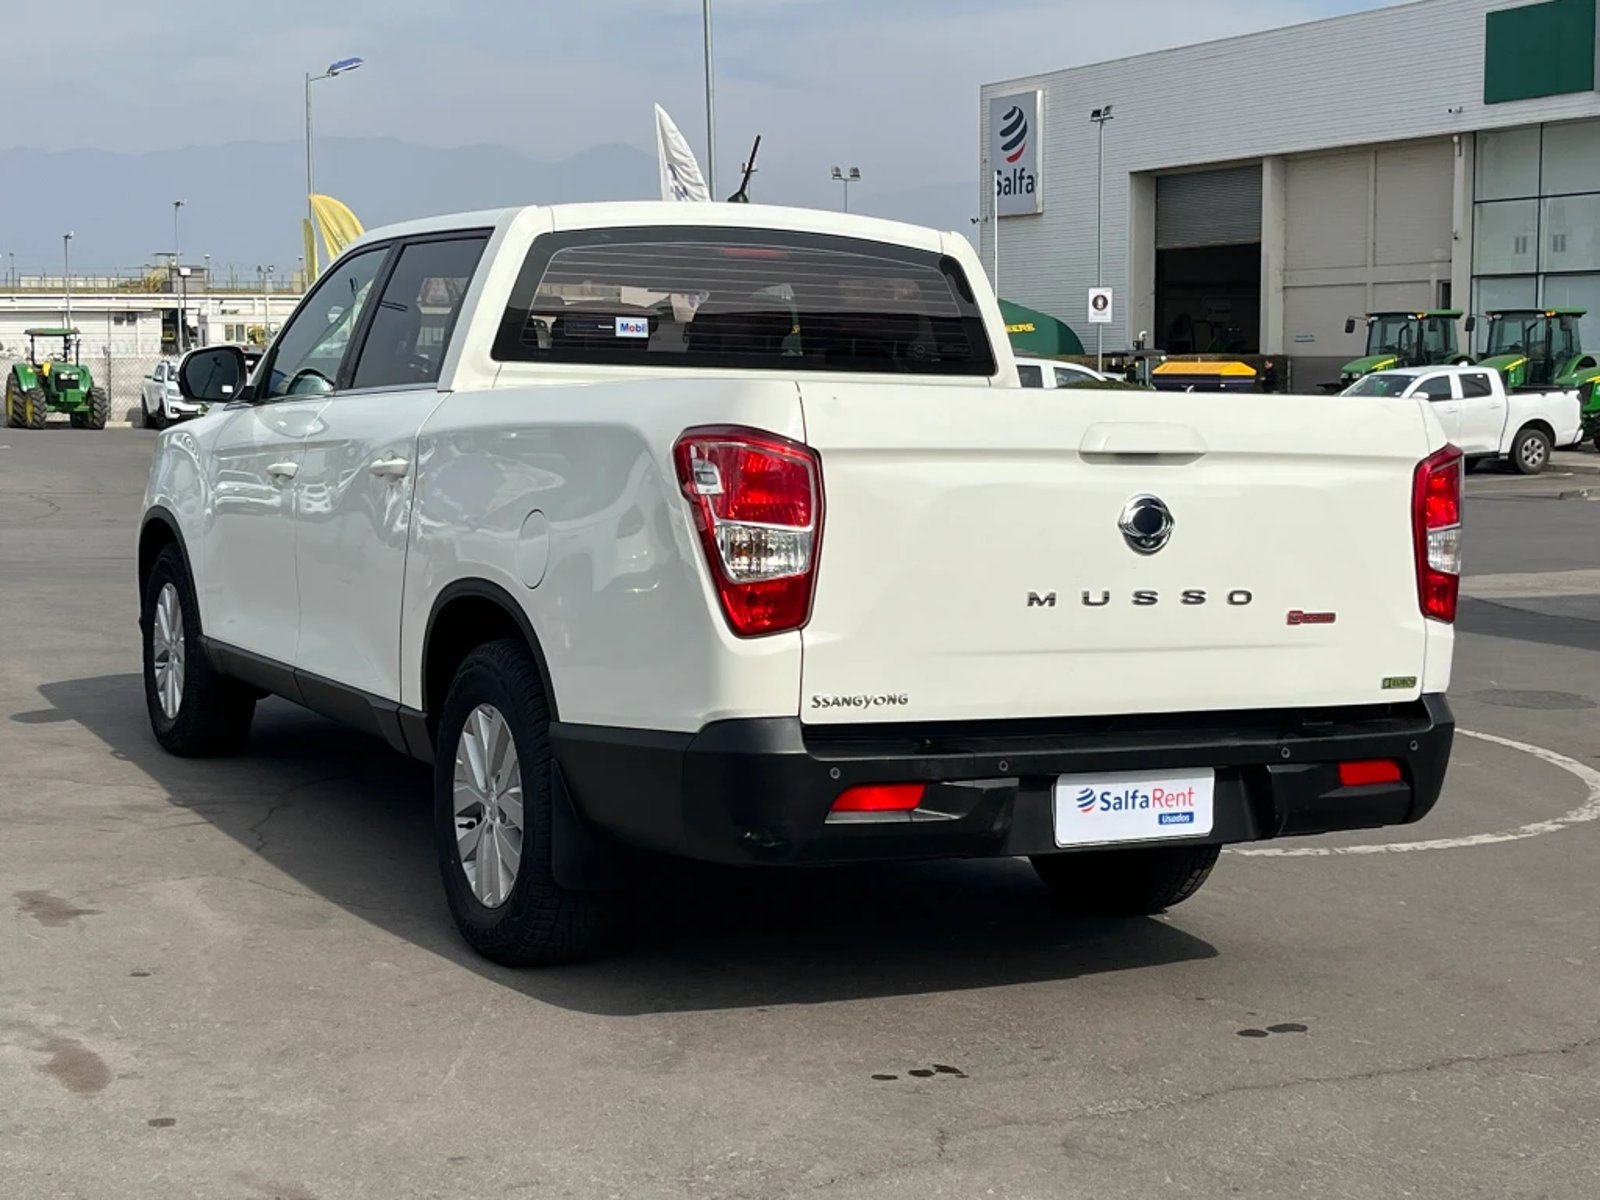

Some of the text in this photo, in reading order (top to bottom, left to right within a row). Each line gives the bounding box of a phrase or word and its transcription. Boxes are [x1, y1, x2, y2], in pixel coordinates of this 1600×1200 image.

[620, 322, 647, 332] Mobil
[1026, 589, 1253, 607] MUSSO
[1099, 786, 1195, 812] SalfaRent
[1161, 812, 1190, 824] Usados
